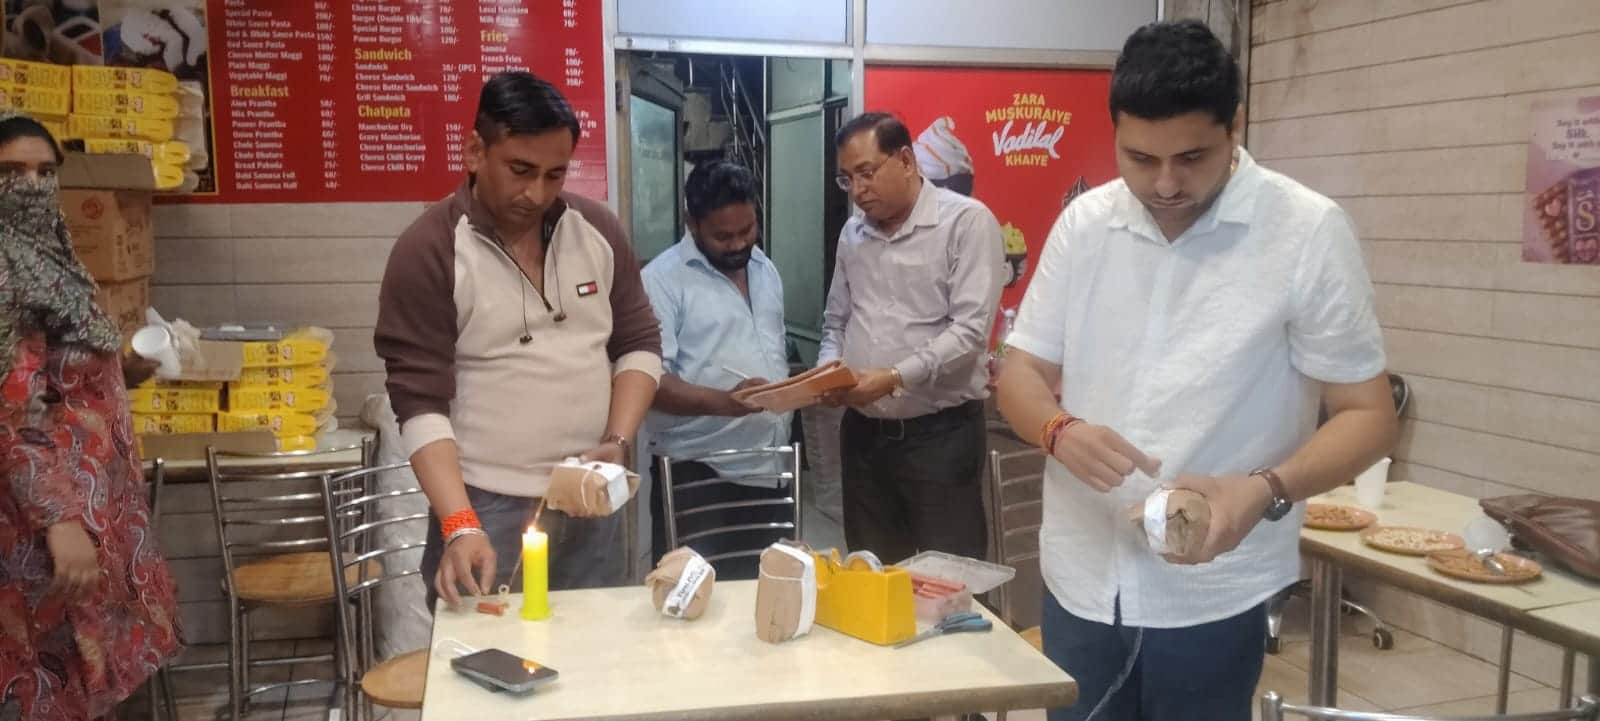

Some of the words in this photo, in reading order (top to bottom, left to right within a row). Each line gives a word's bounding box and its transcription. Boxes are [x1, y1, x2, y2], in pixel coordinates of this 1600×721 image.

[352, 15, 375, 23] Burger
[353, 25, 378, 33] Special
[380, 26, 401, 34] Burger
[379, 36, 401, 44] Burger
[481, 30, 508, 42] Fries
[280, 51, 302, 60] Maggi
[355, 48, 412, 60] Sandwich
[481, 55, 504, 63] French
[248, 62, 270, 70] Maggi
[355, 62, 388, 70] Sandwich
[229, 72, 263, 80] Vegetable
[265, 72, 287, 81] Maggi
[382, 73, 415, 81] Sandwich
[230, 85, 289, 96] Breakfast
[1013, 93, 1045, 106] ZARA
[358, 105, 411, 119] Chatpata
[986, 106, 1072, 125] MUSKURAIYE
[993, 120, 1064, 159] Vadilal
[406, 154, 425, 162] Gravy
[1005, 153, 1048, 166] KHAIYE
[406, 164, 418, 172] Dry
